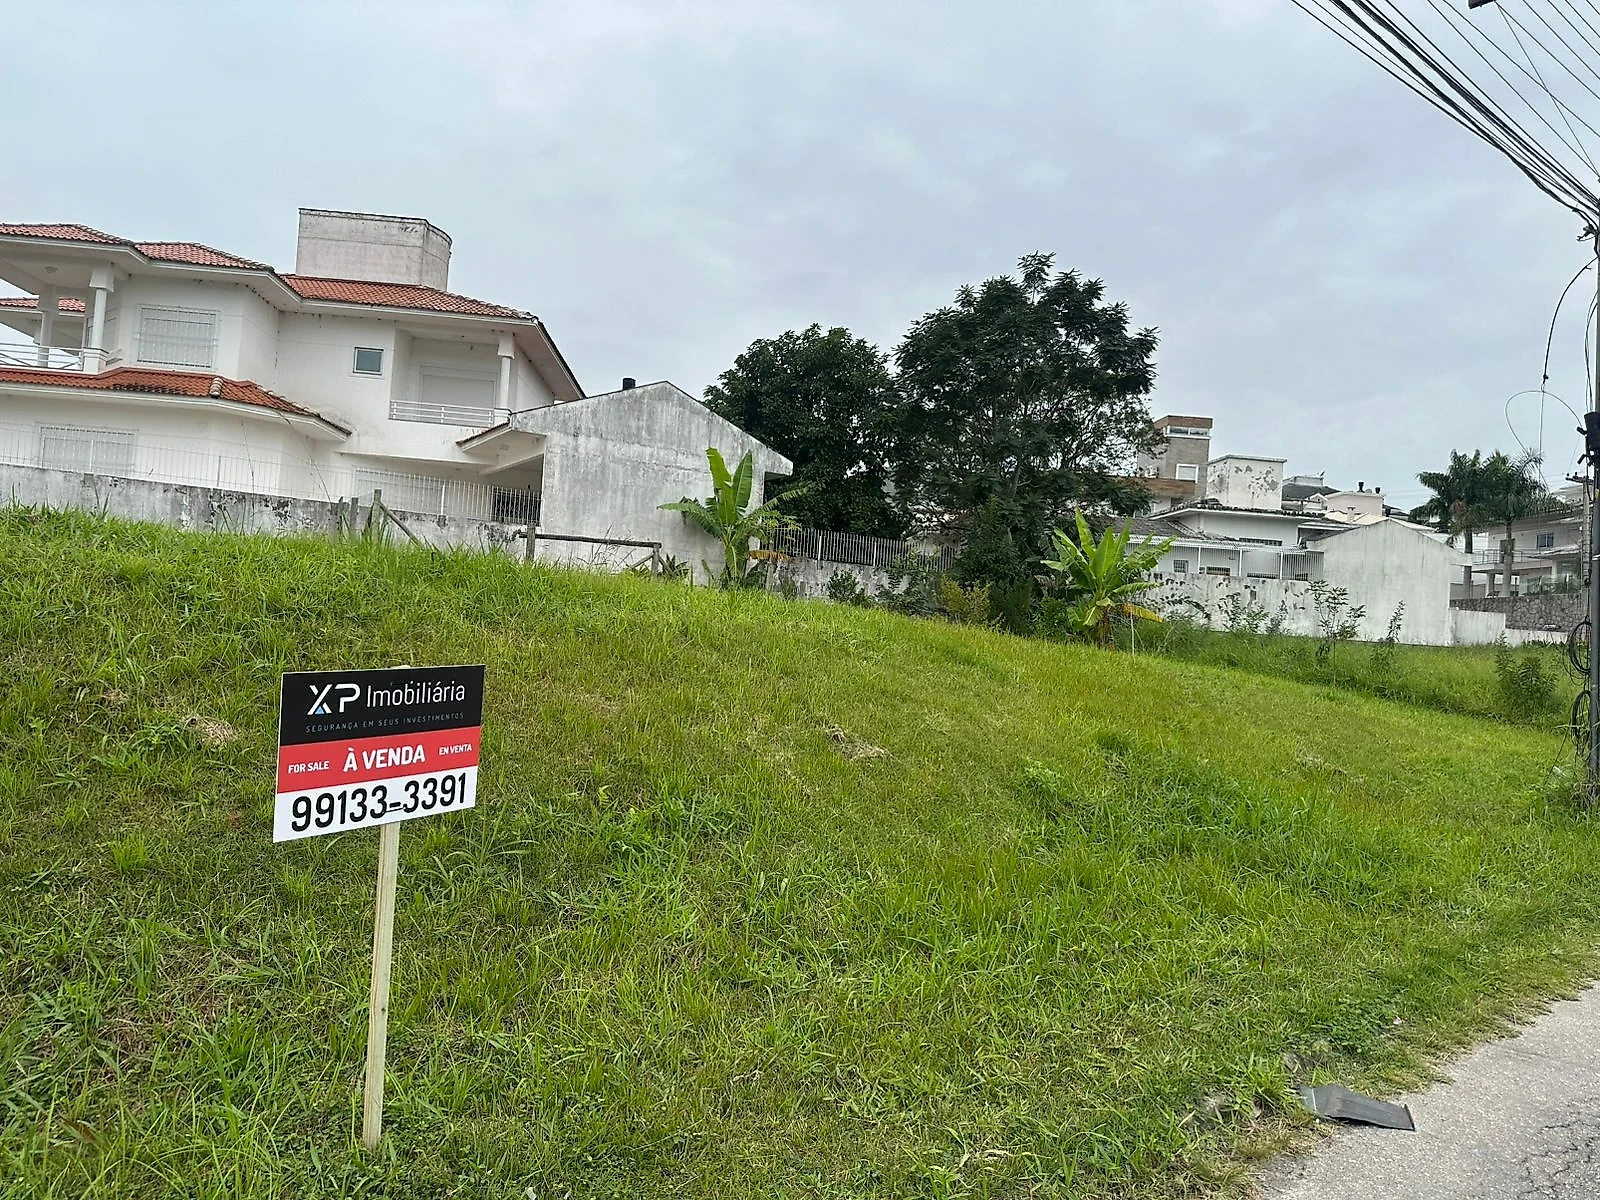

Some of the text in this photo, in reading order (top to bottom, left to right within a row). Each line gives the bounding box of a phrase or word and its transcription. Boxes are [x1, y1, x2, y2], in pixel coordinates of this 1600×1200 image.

[307, 680, 466, 716] XP Imobiliária
[304, 711, 465, 735] SEGURANÇA EM SEUS INVESTIMENTOS
[343, 744, 426, 773] À VENDA
[438, 743, 473, 756] EN VENTA
[287, 760, 330, 774] FOR SALE
[291, 772, 466, 833] 99133-3391
